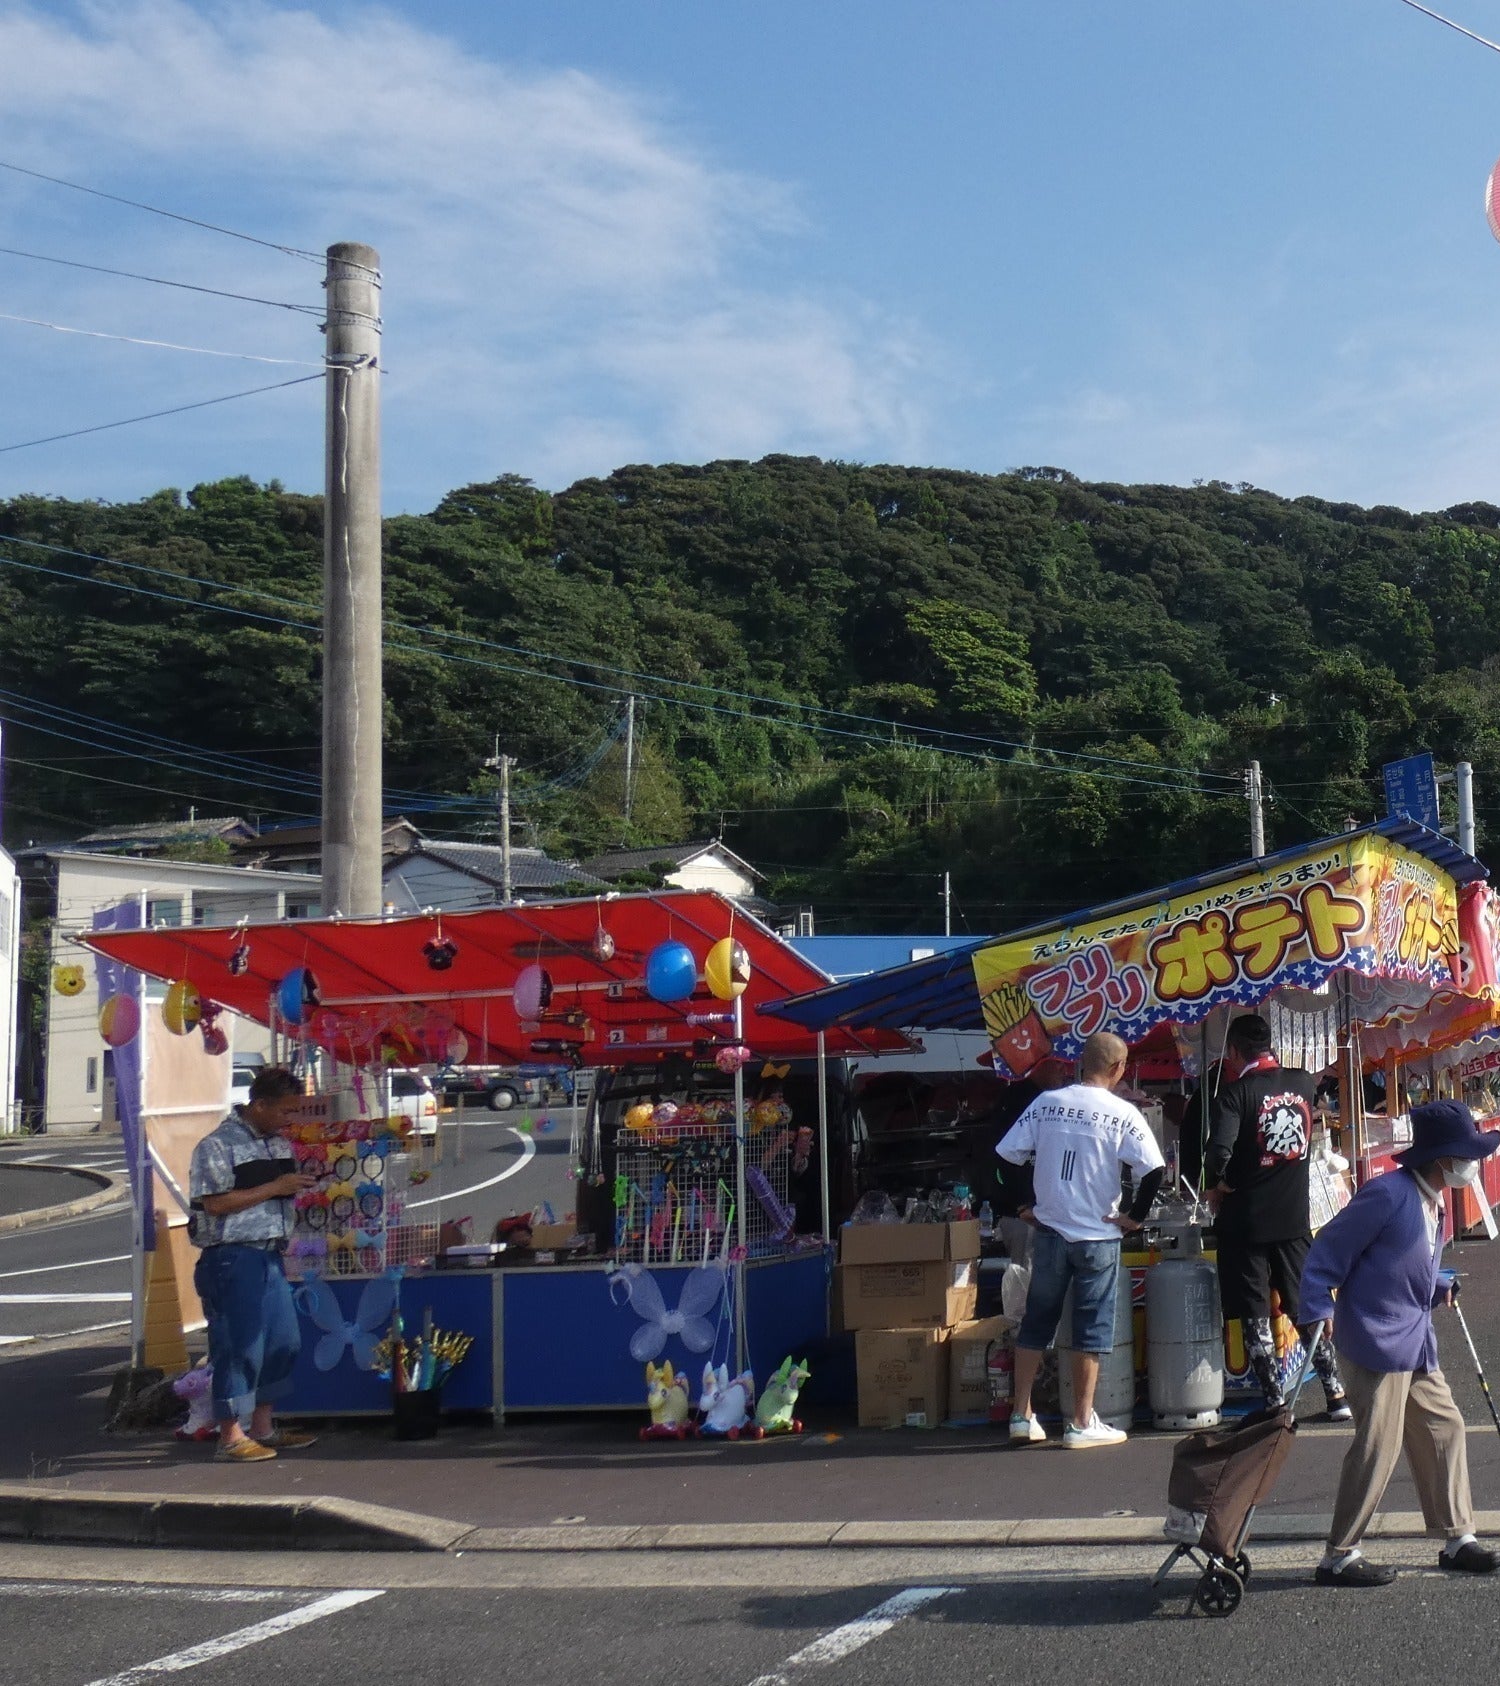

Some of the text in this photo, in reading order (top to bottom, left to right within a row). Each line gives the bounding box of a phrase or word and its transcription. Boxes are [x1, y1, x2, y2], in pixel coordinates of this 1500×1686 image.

[1150, 880, 1368, 1004] ポテト
[1018, 1106, 1146, 1142] THE THREE STRIPES
